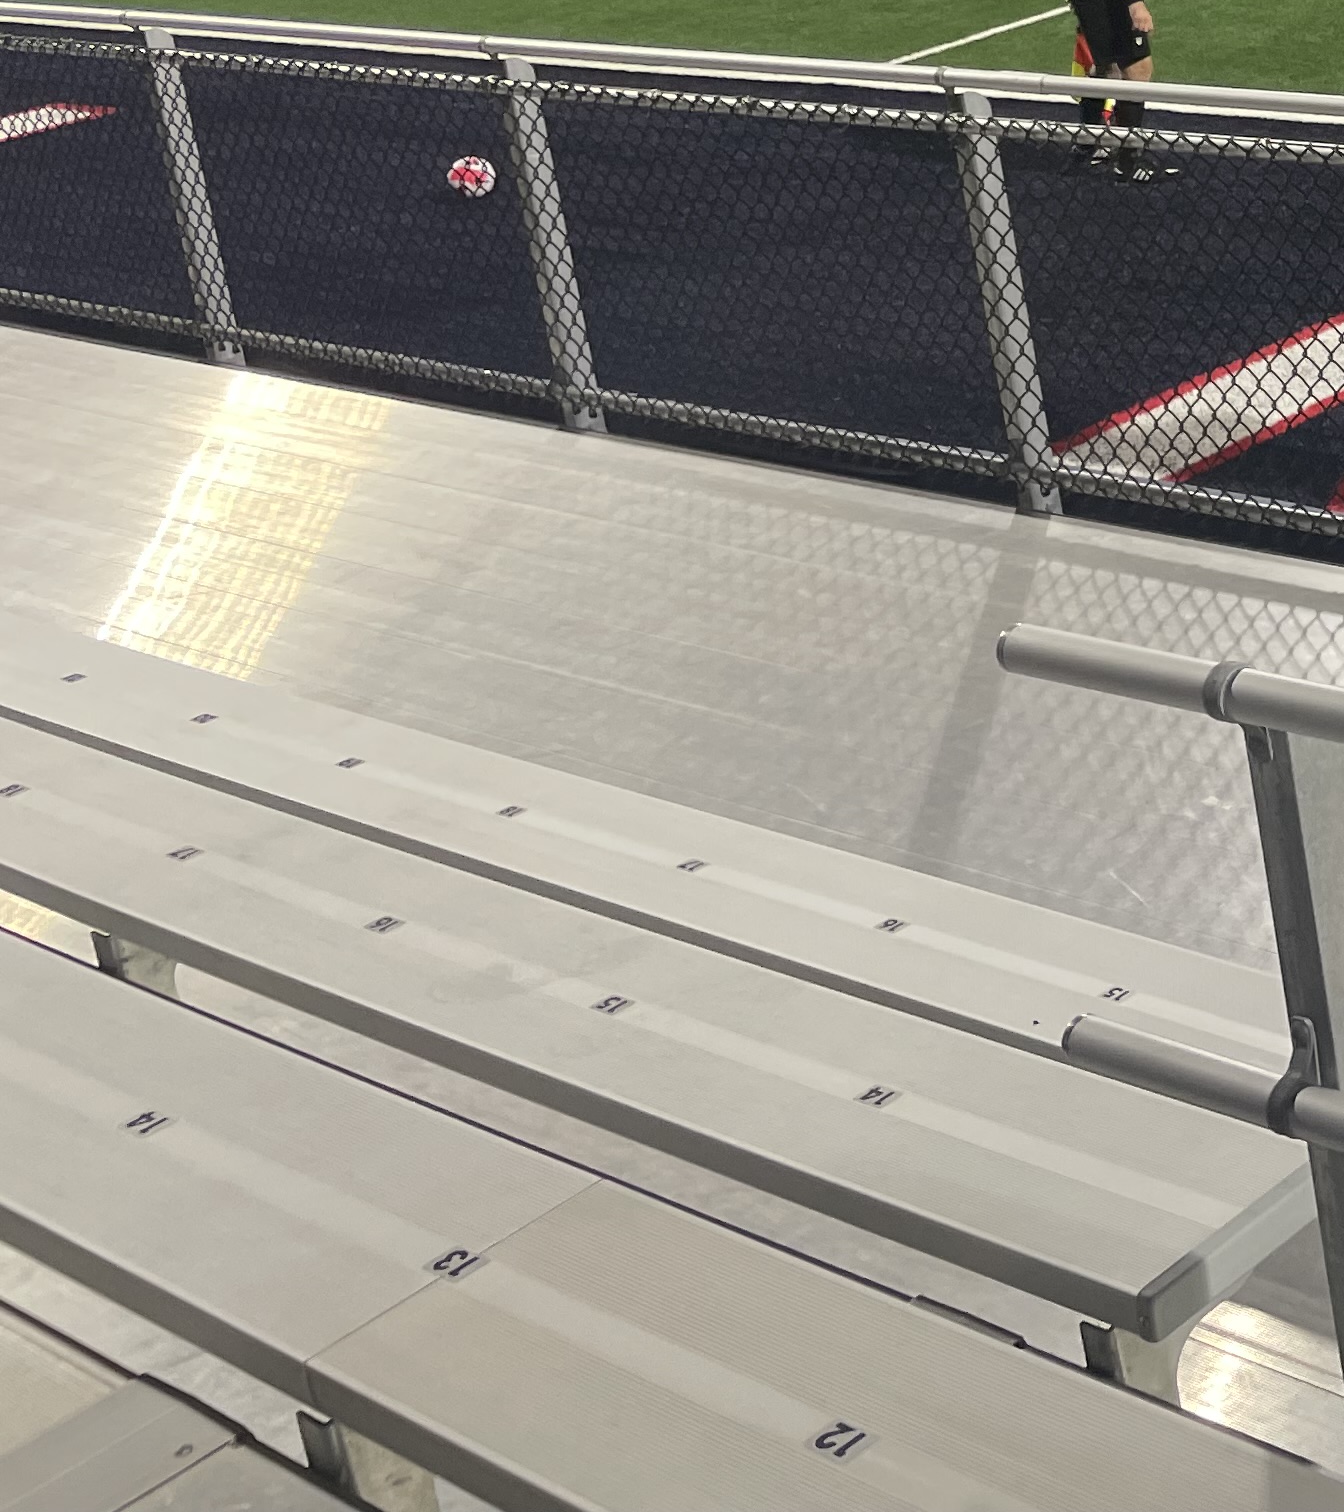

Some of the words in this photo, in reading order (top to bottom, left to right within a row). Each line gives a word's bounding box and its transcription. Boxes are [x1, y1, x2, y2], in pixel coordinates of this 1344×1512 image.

[168, 847, 199, 860] 17
[677, 861, 704, 872] 17
[369, 917, 399, 932] 16
[882, 919, 905, 932] 16
[1103, 987, 1130, 1001] 15
[595, 996, 628, 1014] 15
[859, 1087, 895, 1106] 14
[126, 1111, 168, 1134] 14
[433, 1250, 480, 1277] 13
[815, 1422, 866, 1458] 12
